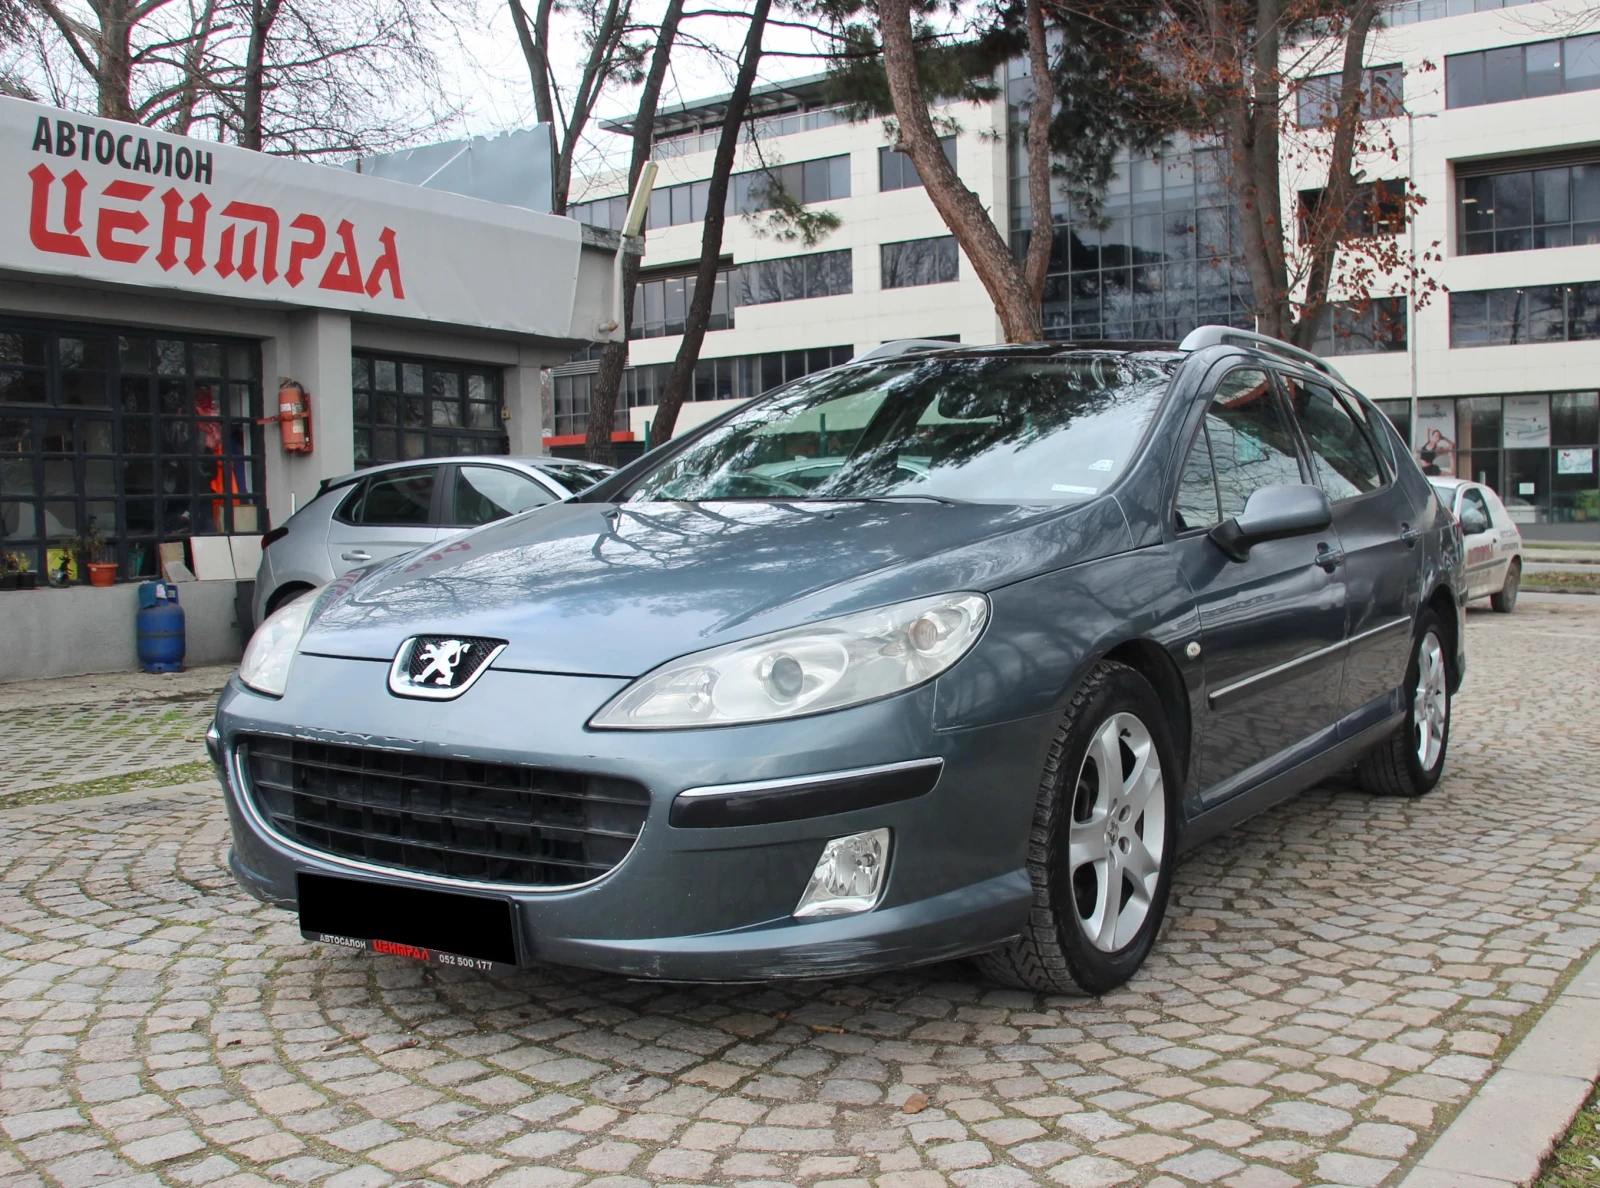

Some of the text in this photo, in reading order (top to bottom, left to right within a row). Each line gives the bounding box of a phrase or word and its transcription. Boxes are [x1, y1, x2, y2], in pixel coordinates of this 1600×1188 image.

[32, 116, 213, 184] АВТОСАЛОН
[28, 162, 405, 300] ЦЕНТРАЛ
[319, 933, 493, 971] АВТОСАЛОН ЦЕНТРАЛ 052 500 177
